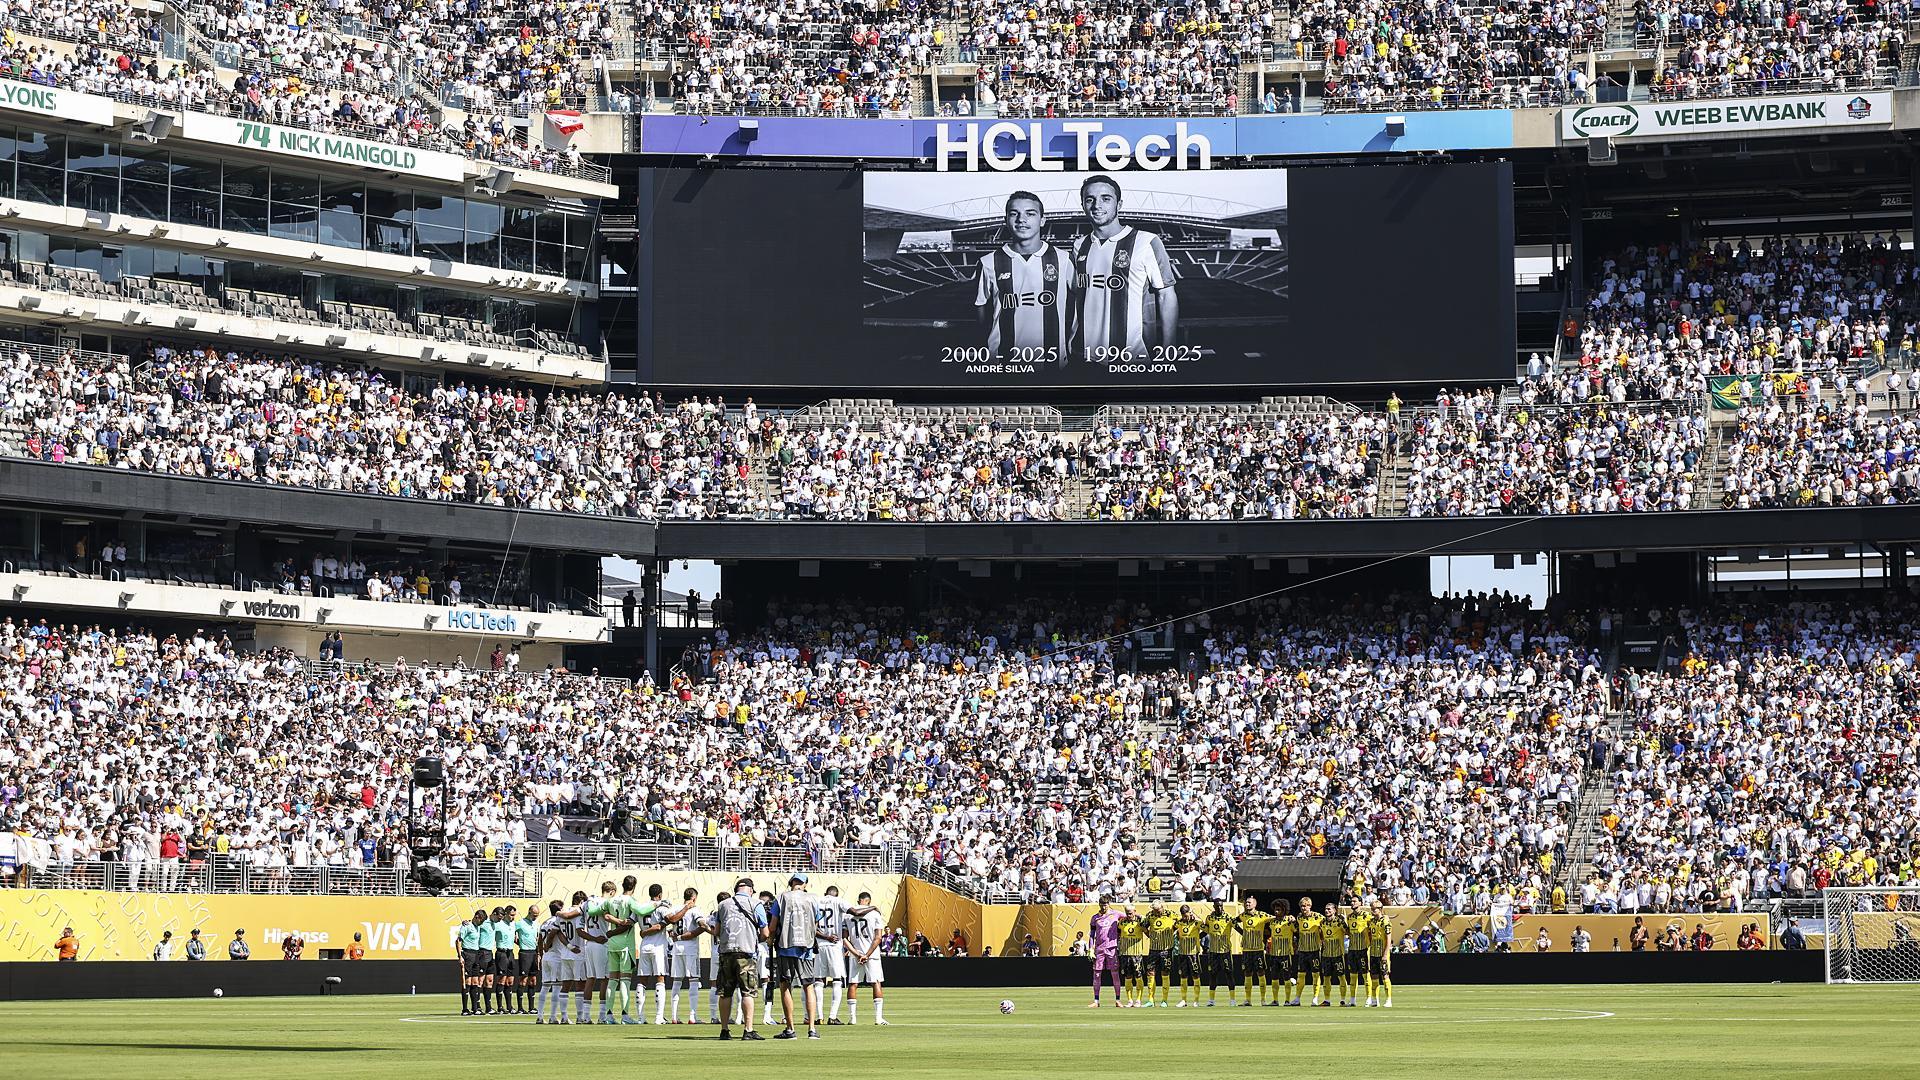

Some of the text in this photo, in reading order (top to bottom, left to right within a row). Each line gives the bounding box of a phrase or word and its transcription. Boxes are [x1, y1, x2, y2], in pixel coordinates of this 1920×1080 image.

[1580, 114, 1631, 128] COACH
[1654, 107, 1722, 127] WEEB
[1726, 101, 1826, 123] EWBANK
[237, 122, 416, 169] 74 NICK MANGOLD
[936, 121, 1211, 171] HCLTech
[941, 346, 990, 363] 2000
[1009, 346, 1058, 363] 2025
[1084, 345, 1133, 362] 1996
[1152, 345, 1202, 362] 2025
[965, 363, 1035, 373] ANDRÉ SILVA
[1108, 363, 1177, 373] DIOGO JOTA
[244, 599, 300, 619] verizon
[448, 610, 517, 631] HCLTech
[817, 908, 834, 928] 22
[360, 921, 422, 951] VISA
